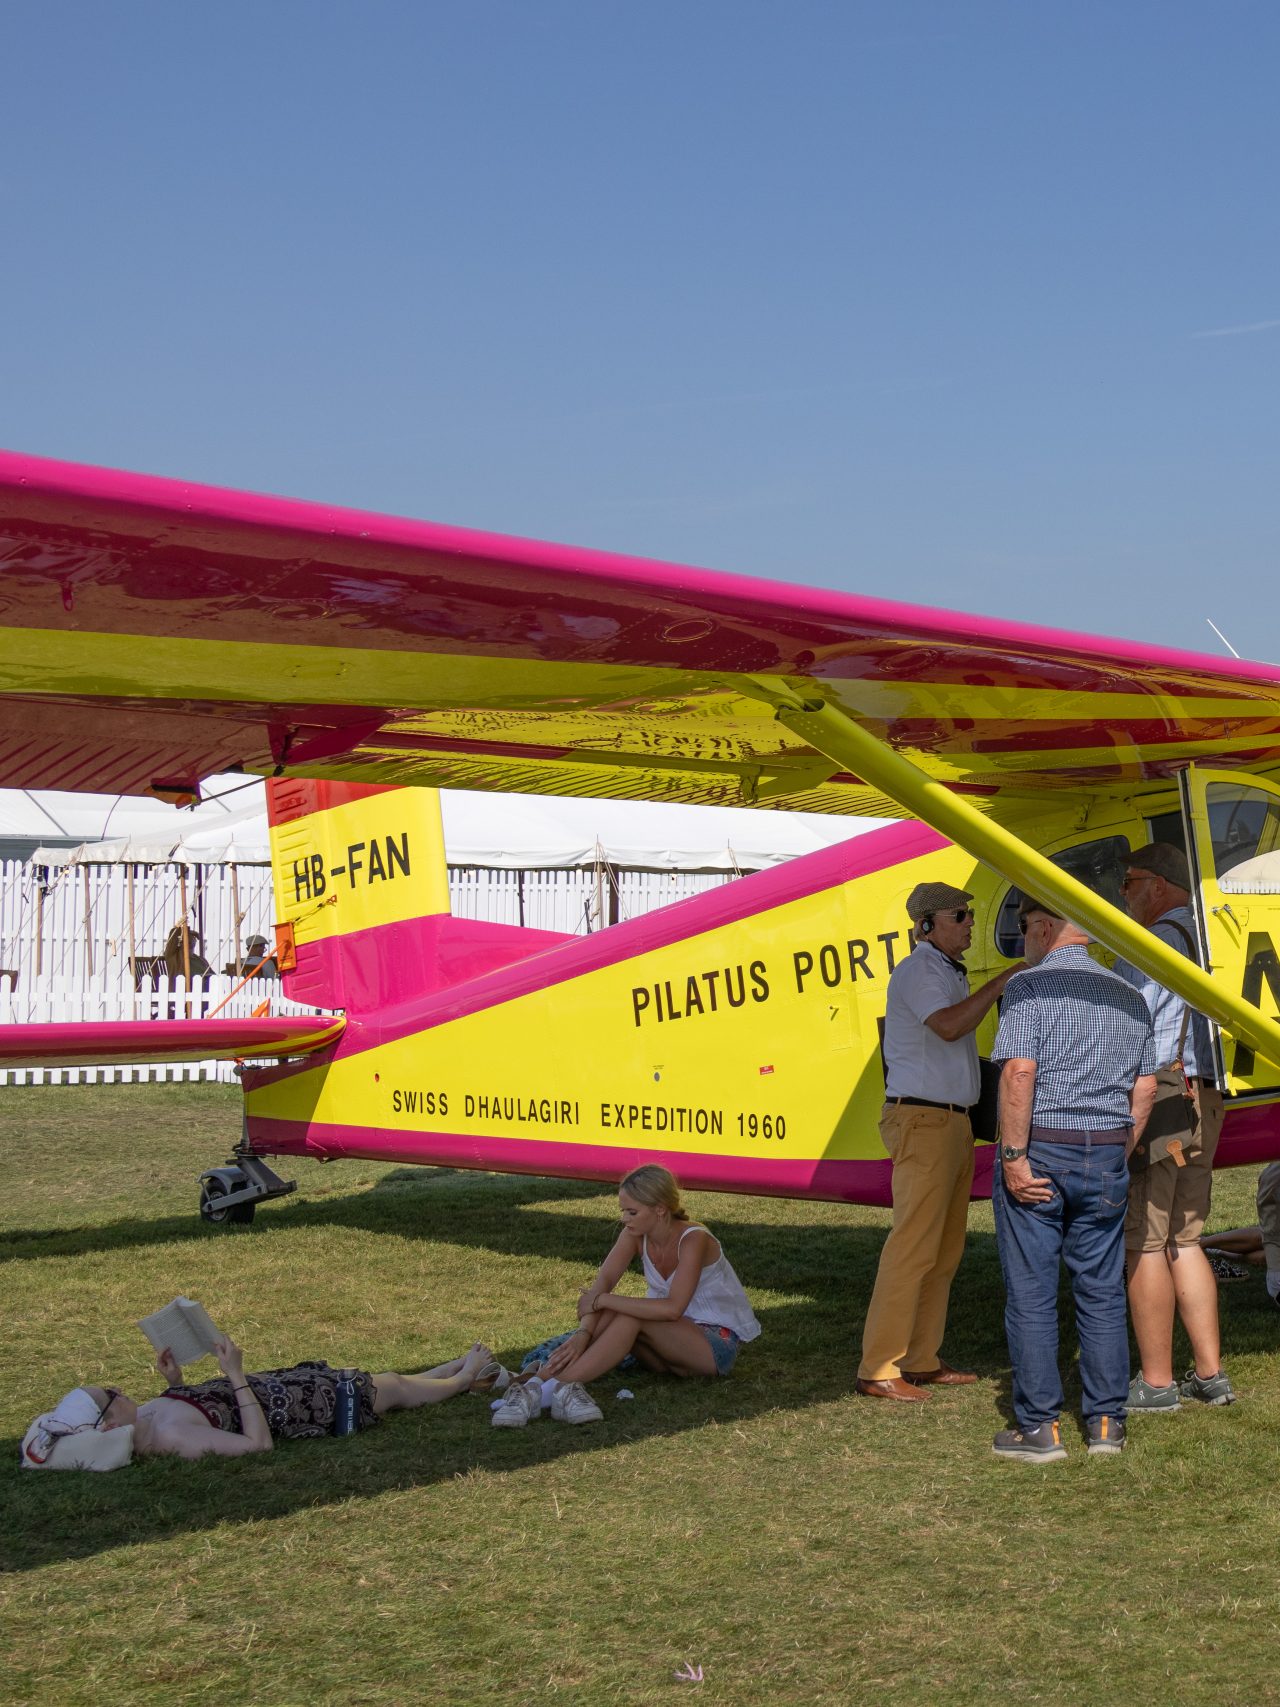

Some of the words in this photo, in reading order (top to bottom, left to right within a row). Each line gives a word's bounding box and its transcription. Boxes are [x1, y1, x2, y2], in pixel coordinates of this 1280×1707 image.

[293, 832, 411, 902] HB-FAN
[632, 960, 770, 1027] PILATUS
[793, 927, 917, 994] PORT
[392, 1089, 449, 1116] SWISS
[464, 1094, 580, 1126] DHAULAGIRI
[600, 1103, 723, 1135] EXPEDITION
[736, 1112, 787, 1141] 1960
